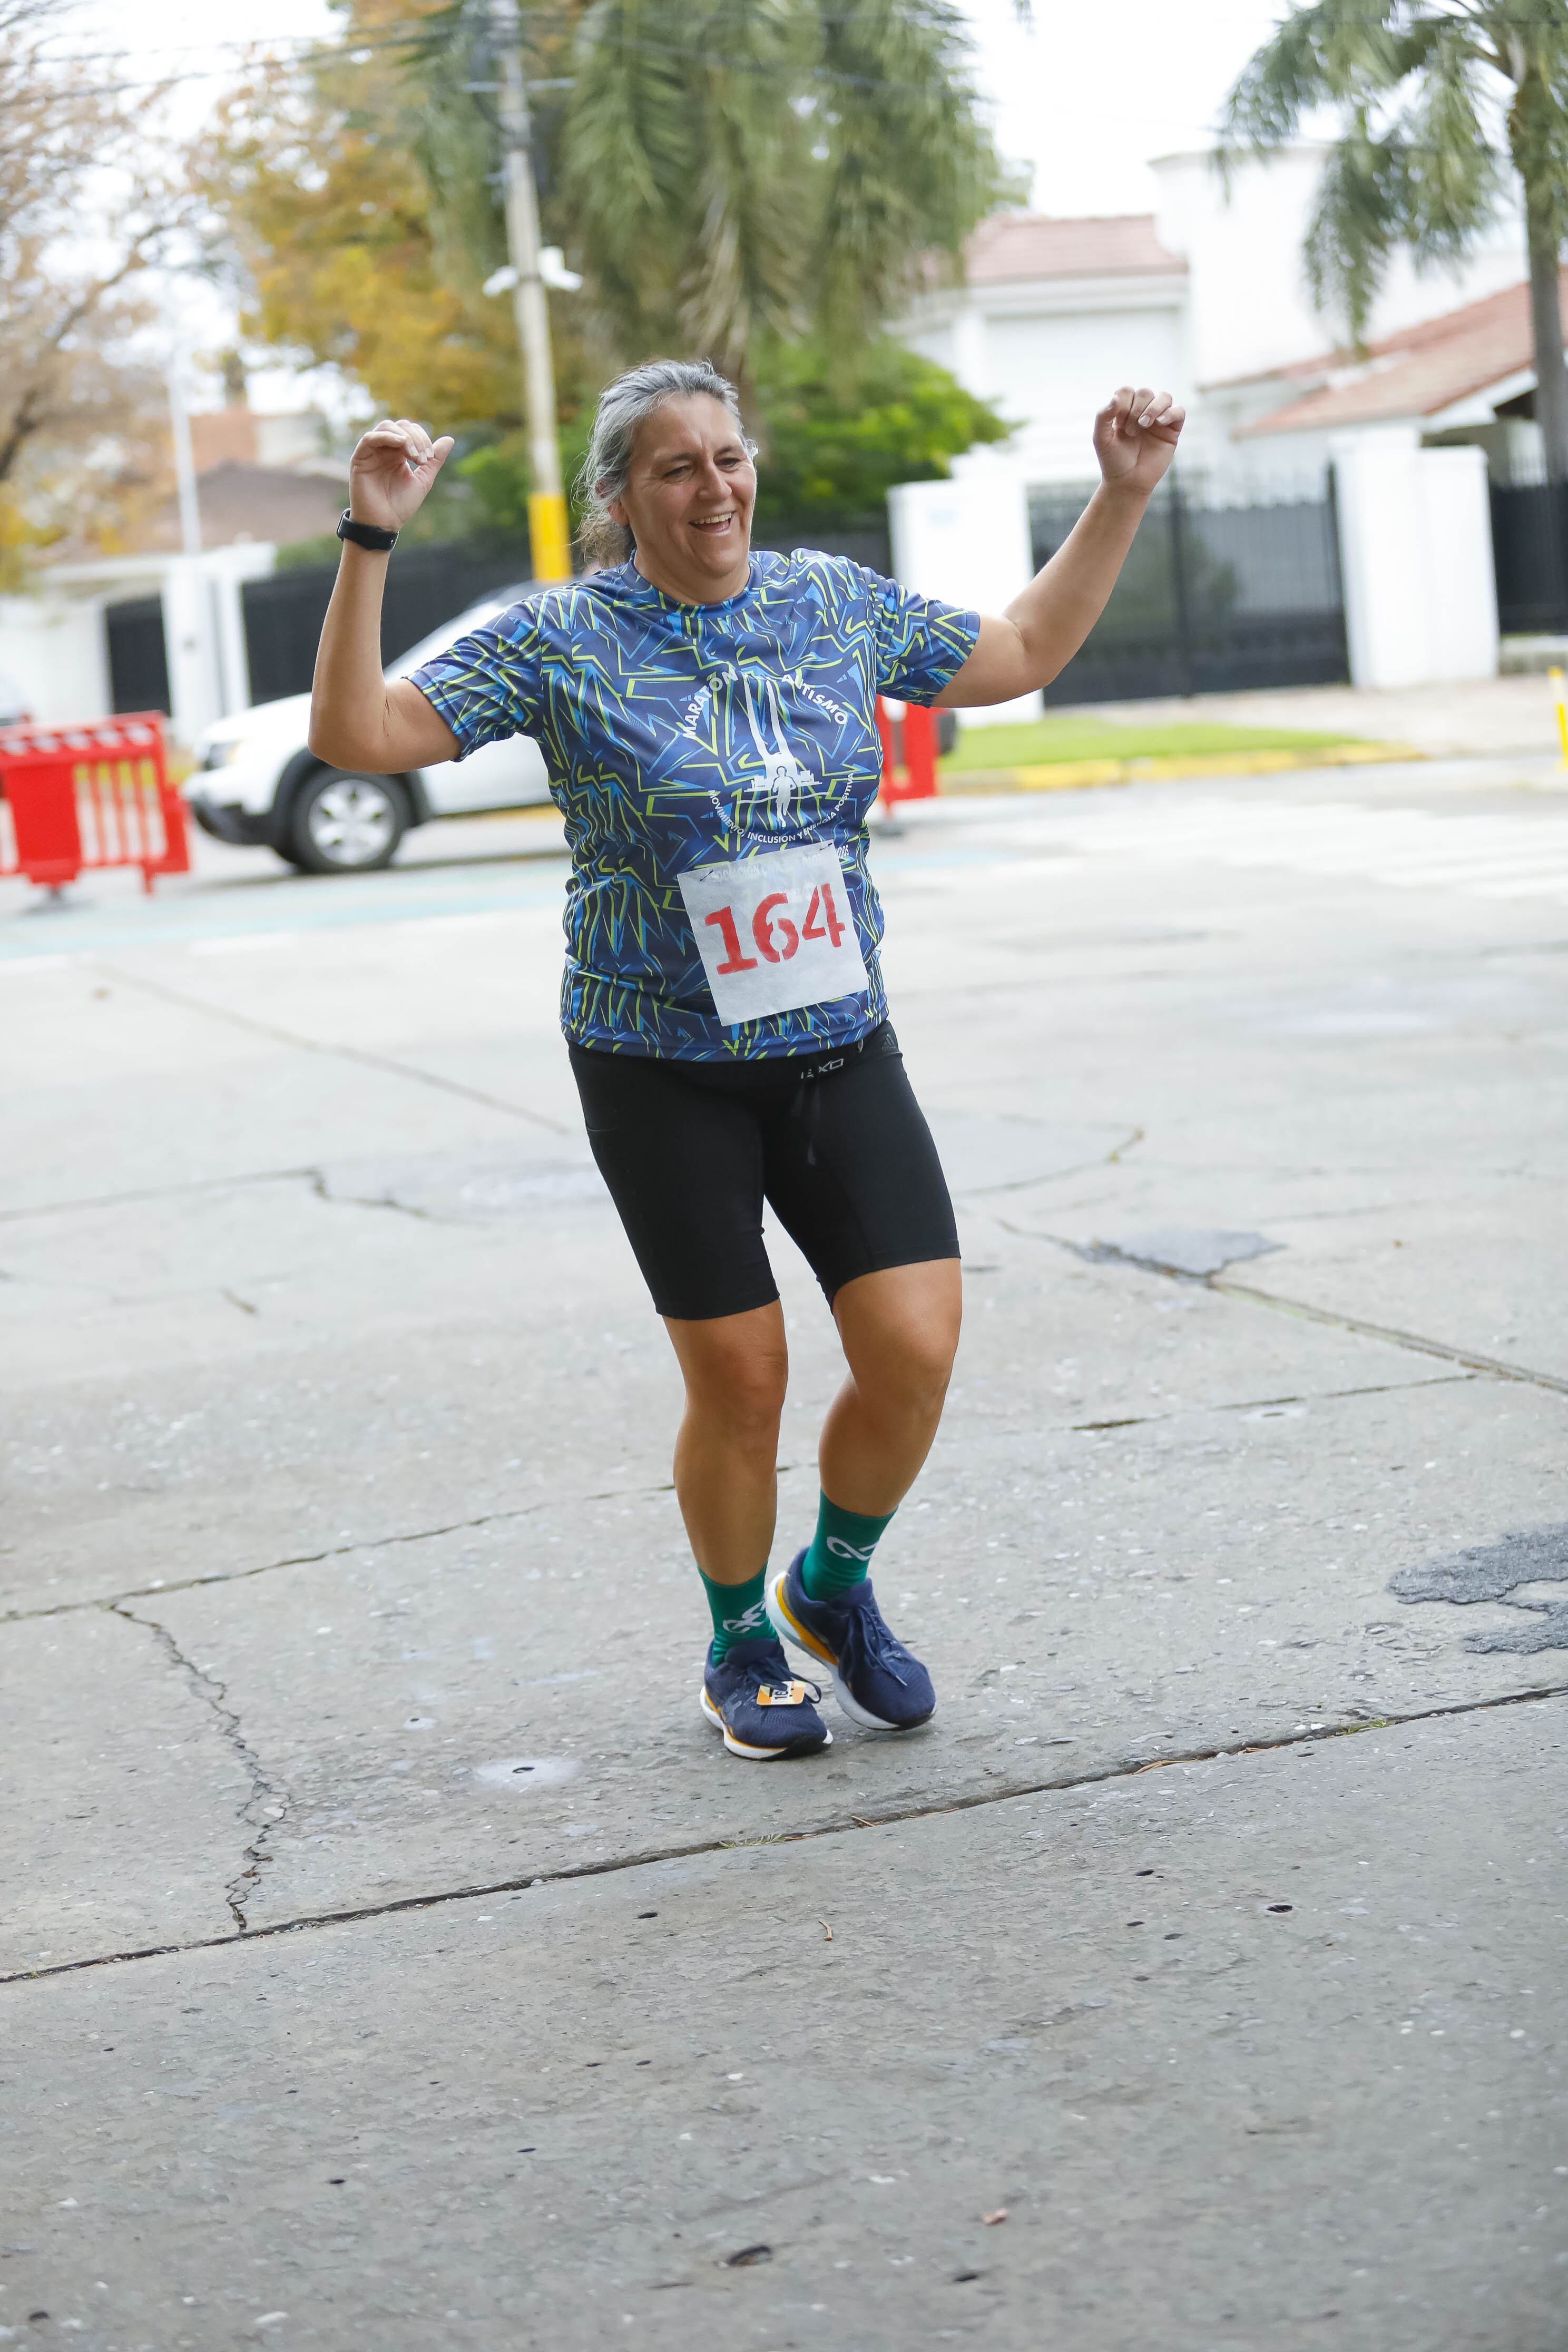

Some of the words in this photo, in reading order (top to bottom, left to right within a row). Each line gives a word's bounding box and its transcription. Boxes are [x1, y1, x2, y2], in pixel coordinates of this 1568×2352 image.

[781, 674, 847, 725] AUTISMO
[708, 789, 746, 837] MOVIMIENTO,
[797, 831, 802, 839] Y
[834, 772, 855, 812] POSITIVA
[704, 883, 846, 975] 164
